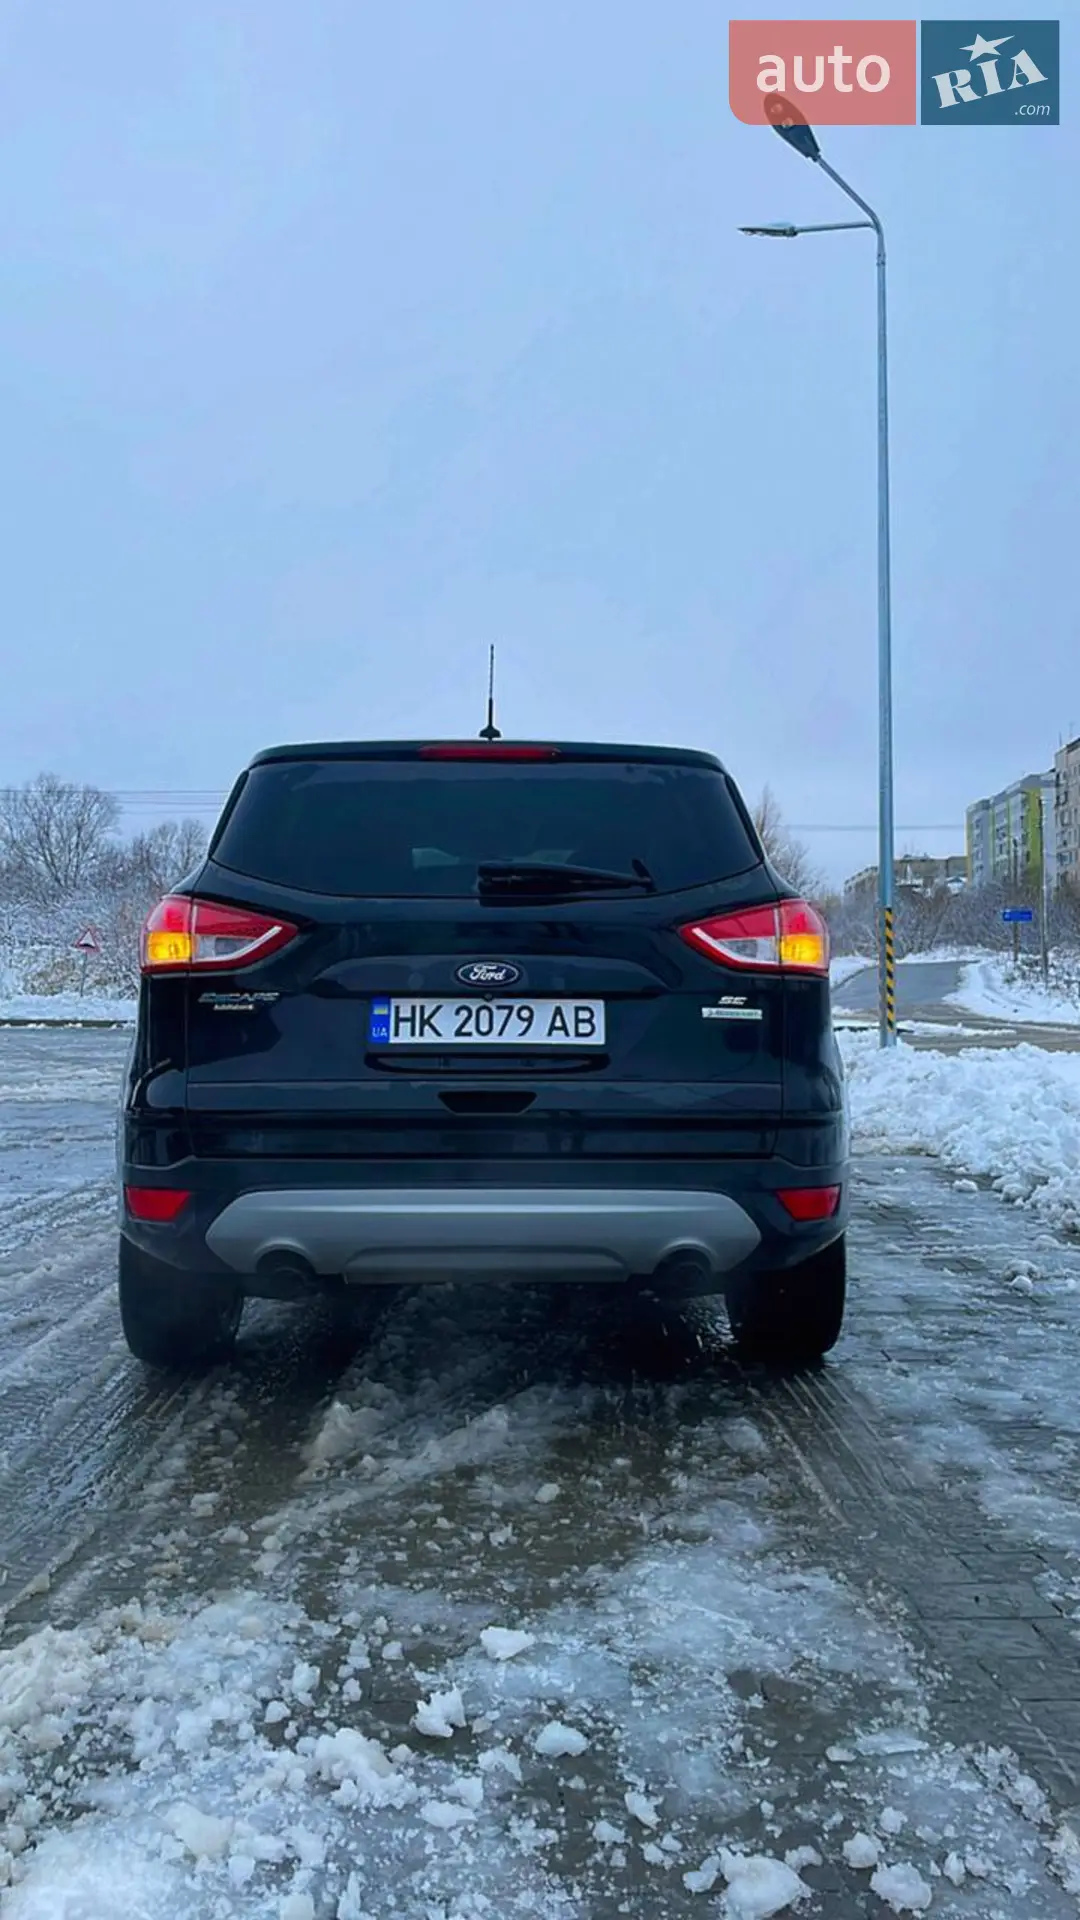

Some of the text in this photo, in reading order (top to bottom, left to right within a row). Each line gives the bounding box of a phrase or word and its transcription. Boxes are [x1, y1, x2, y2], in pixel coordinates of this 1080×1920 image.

[469, 963, 506, 981] Ford
[393, 1004, 597, 1038] HK 2079 AB
[372, 1027, 388, 1037] UA
